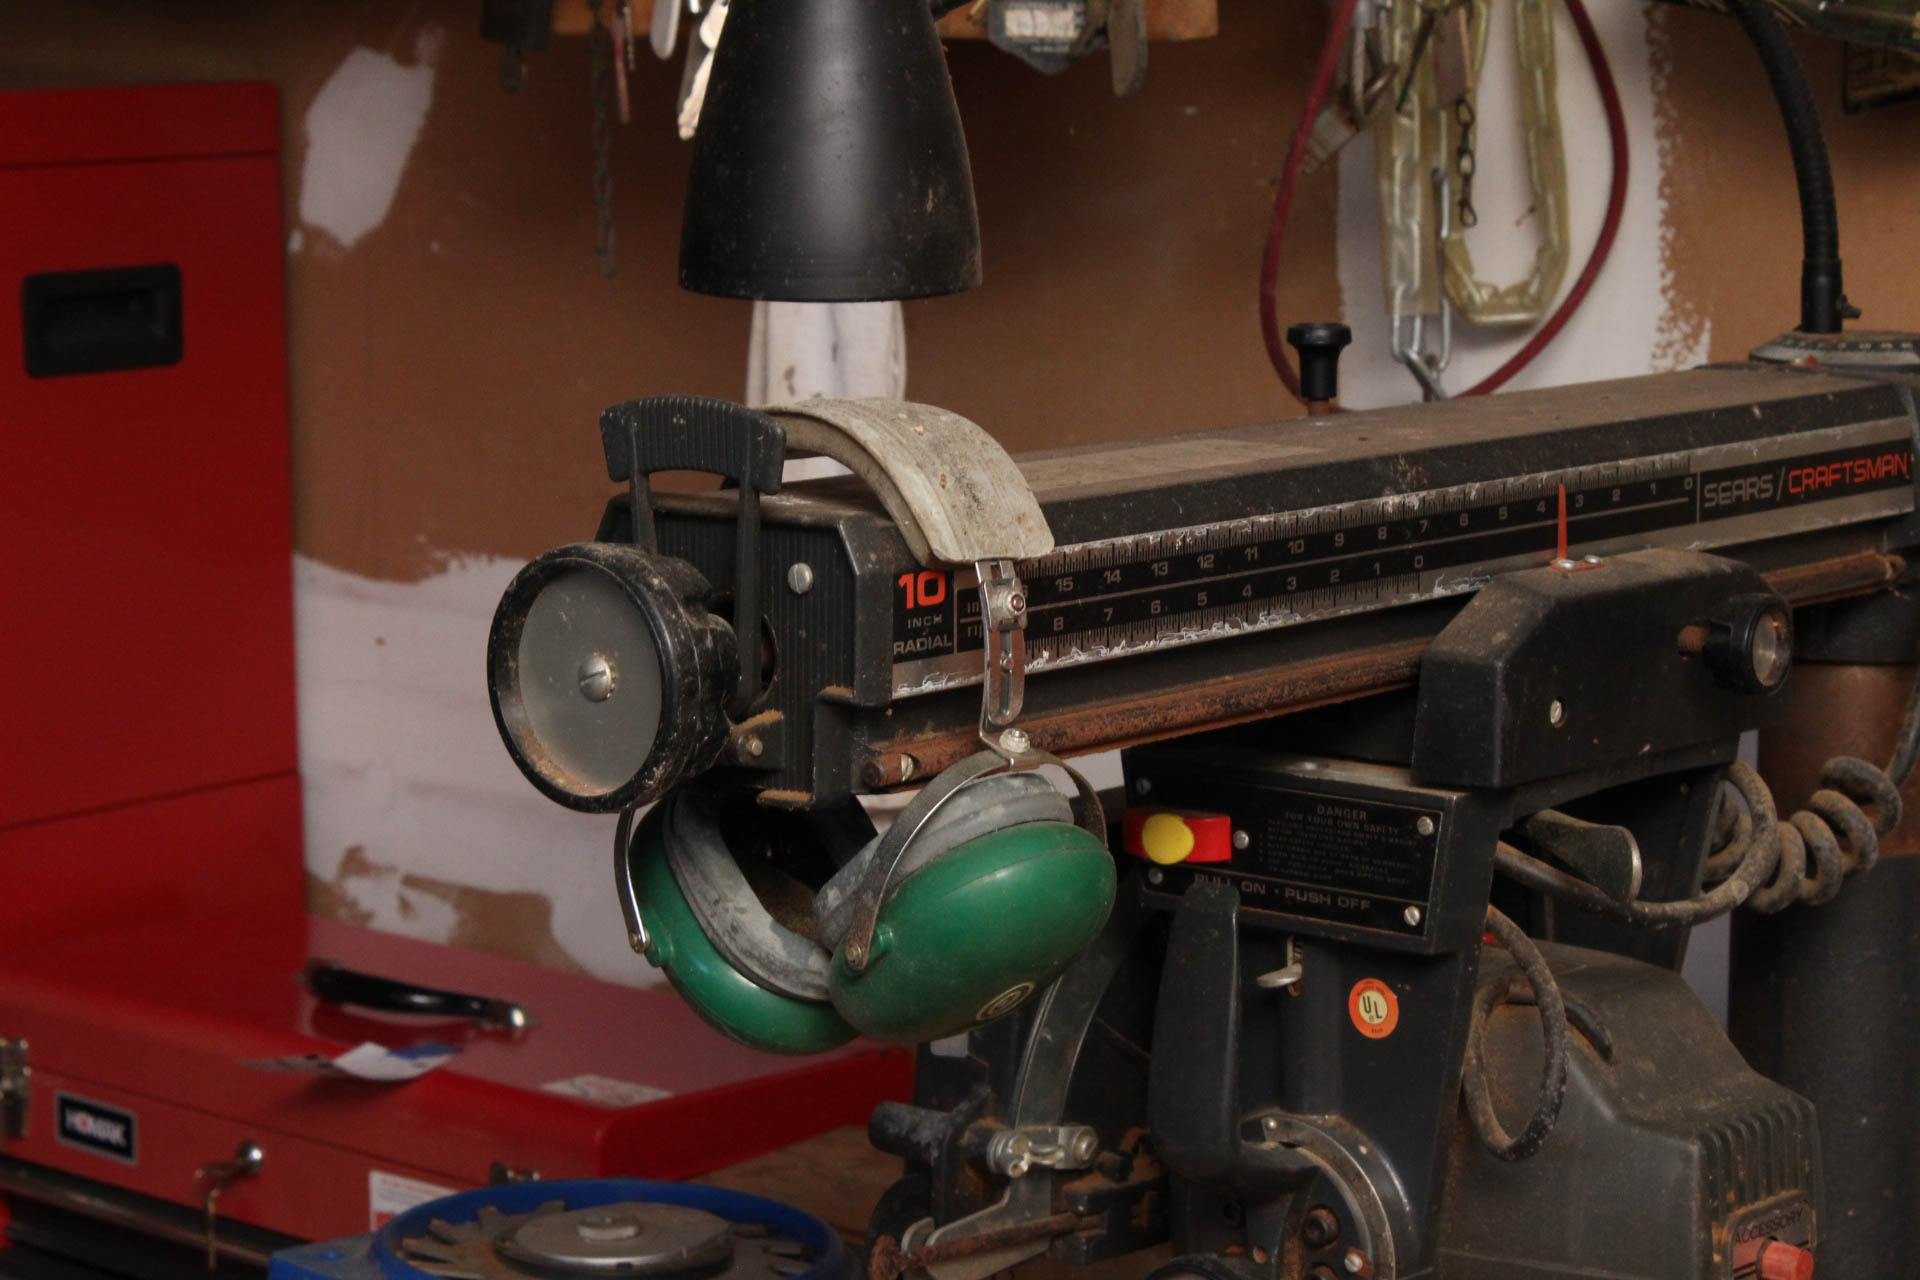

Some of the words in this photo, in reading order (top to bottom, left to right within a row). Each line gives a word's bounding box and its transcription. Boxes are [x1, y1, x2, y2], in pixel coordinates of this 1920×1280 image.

[1703, 474, 1773, 508] SEARS
[1788, 451, 1908, 494] CRAFTSMAN
[1056, 577, 1074, 592] 15
[1103, 569, 1121, 584] 14
[1151, 561, 1169, 576] 13
[1196, 553, 1215, 568] 12
[1244, 546, 1259, 561] 11
[1288, 539, 1305, 554] 10
[1335, 532, 1345, 547] 9
[1377, 526, 1388, 541] 8
[1419, 520, 1428, 534] 7
[1459, 513, 1469, 527] 6
[1499, 506, 1508, 520] 5
[1536, 501, 1546, 513] 4
[1576, 495, 1584, 508] 3
[1612, 488, 1621, 502] 2
[1649, 482, 1657, 495] 1
[1684, 477, 1693, 490] 0
[898, 570, 947, 609] 10
[1053, 616, 1064, 631] 8
[1103, 608, 1113, 622] 7
[1151, 600, 1161, 614] 6
[1197, 592, 1207, 606] 5
[1242, 584, 1252, 598] 4
[1287, 576, 1297, 590] 3
[1330, 569, 1341, 583] 2
[1373, 562, 1381, 576] 1
[1414, 554, 1424, 569] 0
[907, 613, 943, 629] INCH
[893, 633, 952, 655] RADIAL
[1316, 804, 1369, 821] DANGER
[1240, 880, 1267, 896] ON
[1284, 887, 1332, 905] PUSH
[1337, 896, 1372, 910] OFF
[1362, 995, 1383, 1019] UL
